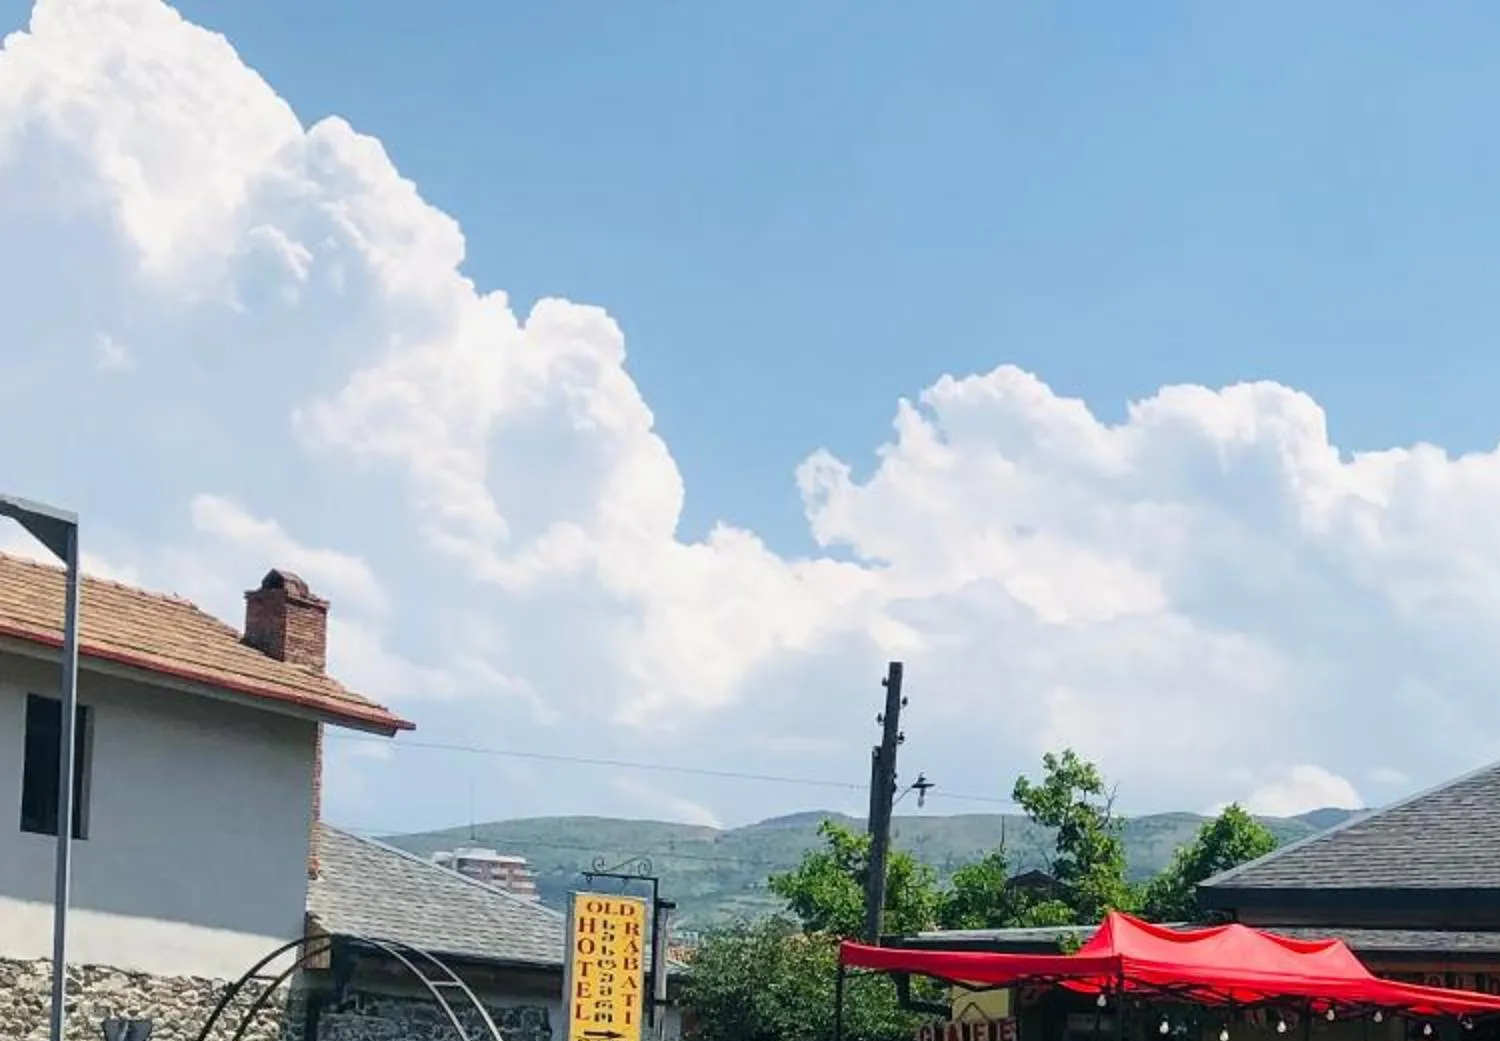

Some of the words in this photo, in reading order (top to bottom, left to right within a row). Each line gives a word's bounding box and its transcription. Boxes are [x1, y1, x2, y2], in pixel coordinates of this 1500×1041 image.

[587, 902, 635, 916] OLD
[576, 917, 595, 1020] HOTEL
[621, 921, 640, 1024] RABATI
